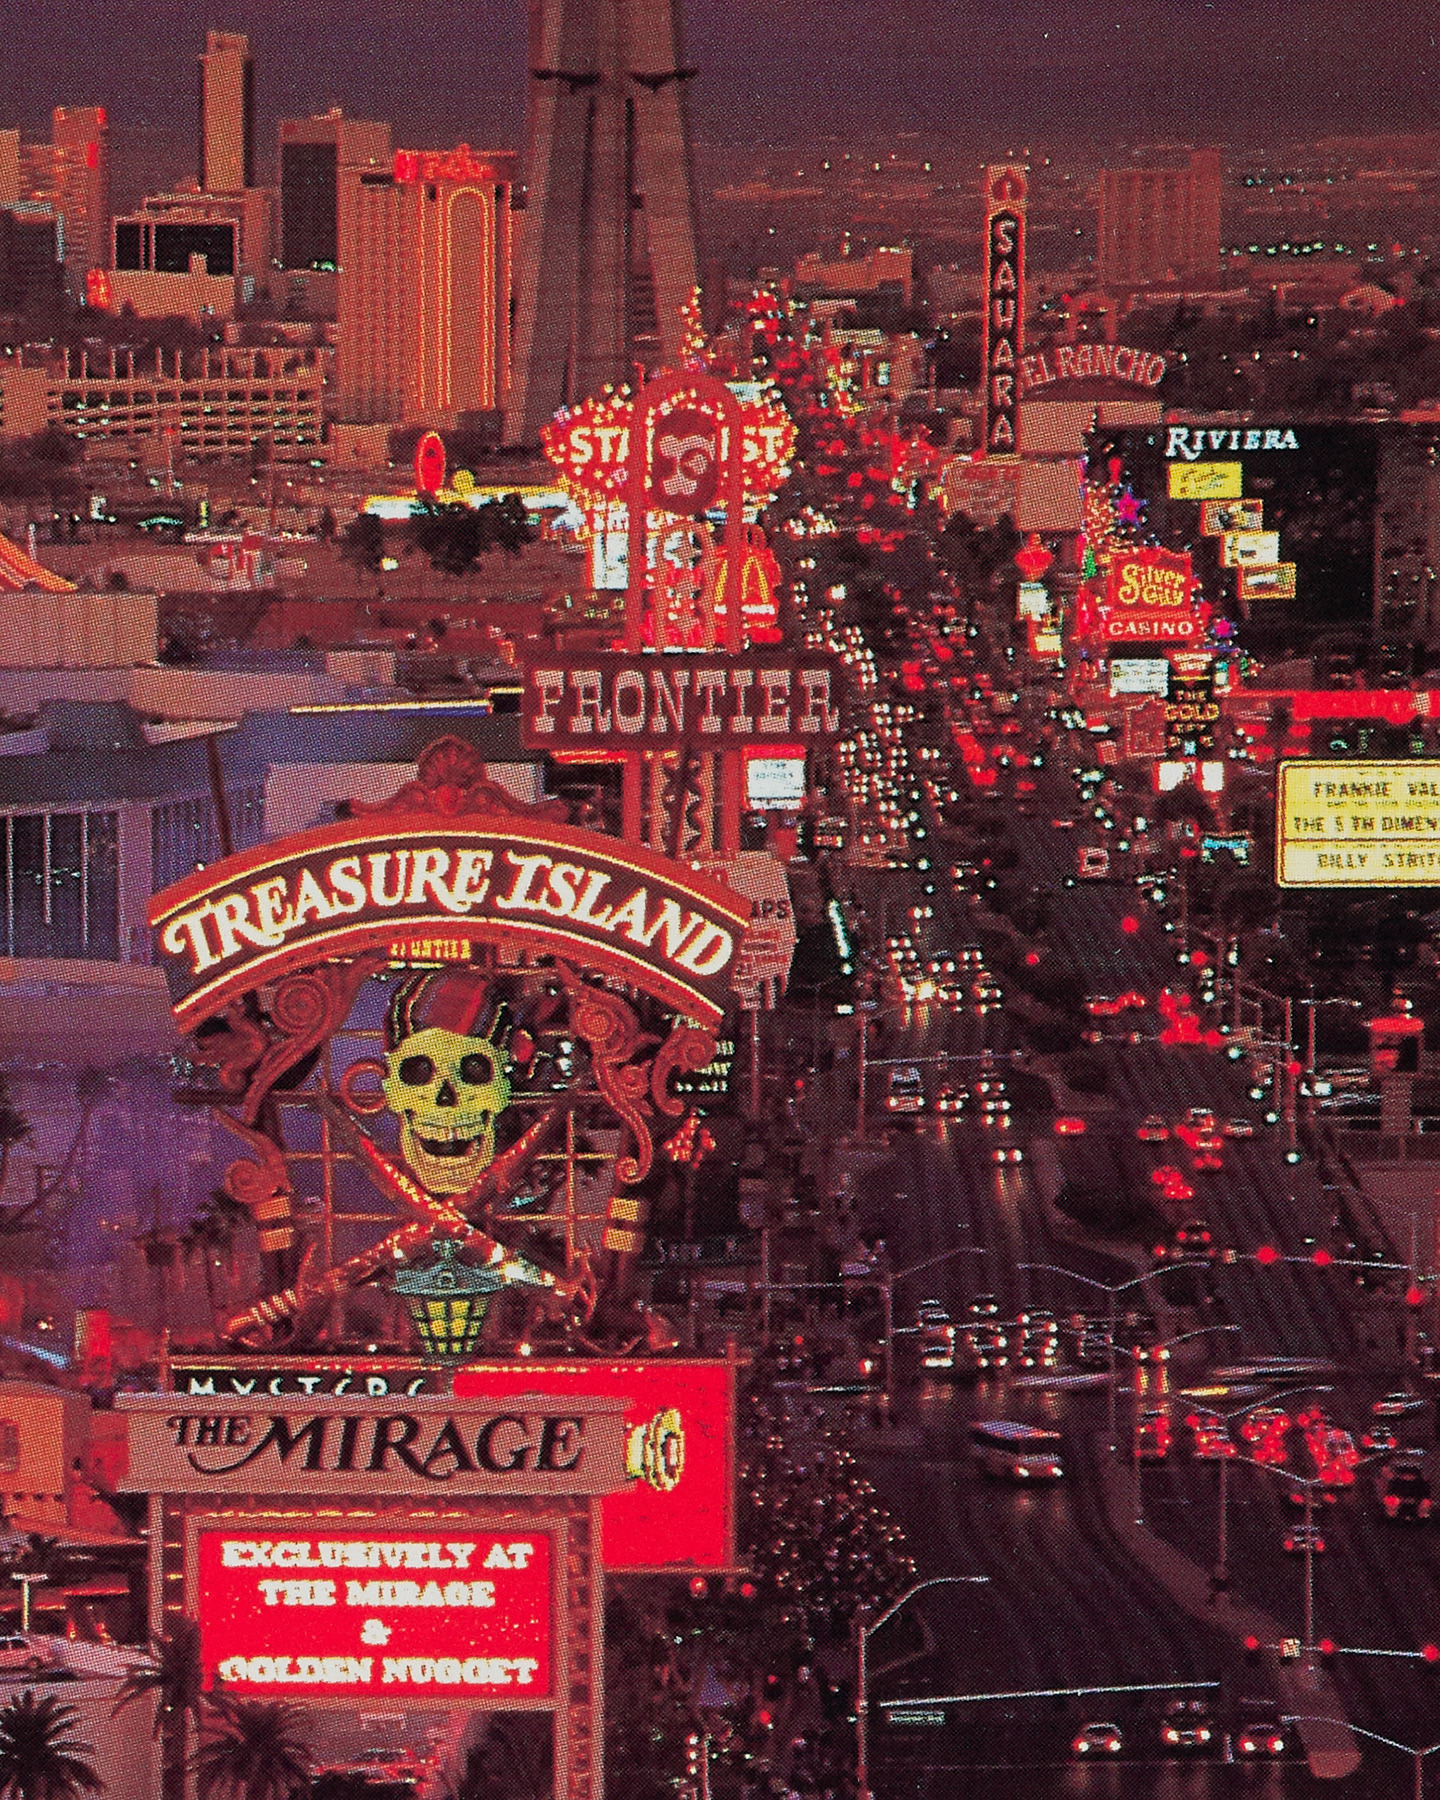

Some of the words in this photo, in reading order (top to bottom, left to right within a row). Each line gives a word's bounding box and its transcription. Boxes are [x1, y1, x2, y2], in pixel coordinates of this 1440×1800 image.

[992, 219, 1017, 445] SAHARA
[1019, 352, 1056, 387] EL
[1055, 344, 1167, 387] RANCHO
[1165, 426, 1300, 460] RIVIERA
[1117, 563, 1186, 604] Silver
[1141, 583, 1184, 607] City
[1108, 620, 1194, 636] CASINO
[532, 669, 839, 734] FRONTIER
[1313, 781, 1392, 797] FRANKIE
[1294, 816, 1325, 832] THE
[1317, 853, 1368, 869] BILLY
[165, 848, 493, 976] TREASURE
[496, 850, 734, 976] ISLAND
[167, 1414, 251, 1446] THE
[188, 1413, 584, 1480] MIRAGE
[221, 1541, 477, 1568] EXCLUSIVELY
[483, 1542, 534, 1569] AT
[258, 1579, 337, 1606] THE
[345, 1580, 496, 1607] MIRAGE
[360, 1618, 392, 1645] &
[218, 1656, 373, 1683] GOLDEN
[382, 1656, 538, 1684] NUGGET
